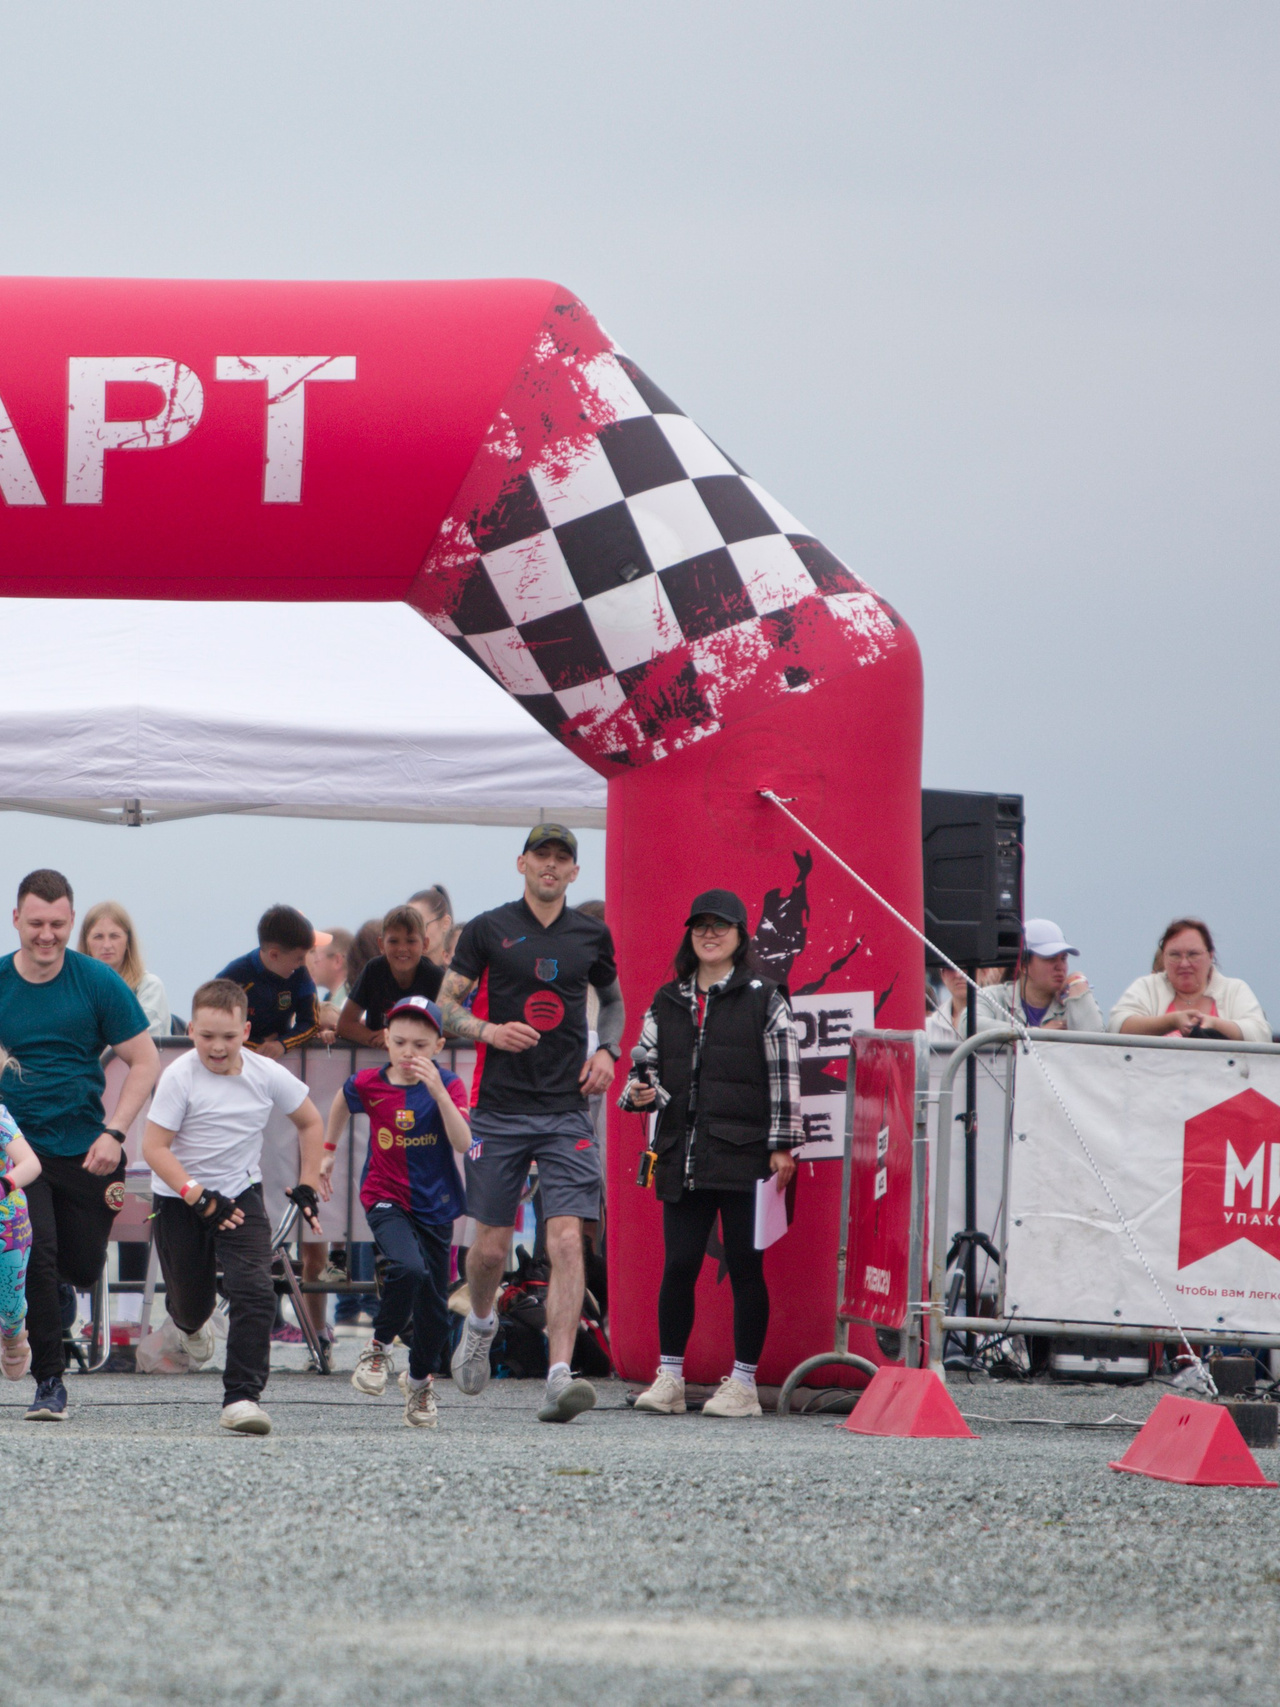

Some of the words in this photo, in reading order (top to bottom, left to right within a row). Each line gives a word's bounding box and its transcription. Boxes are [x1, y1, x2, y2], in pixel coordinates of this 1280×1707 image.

[396, 1134, 437, 1147] Spotify
[1175, 1284, 1217, 1297] Чтобы
[1221, 1288, 1245, 1299] вам
